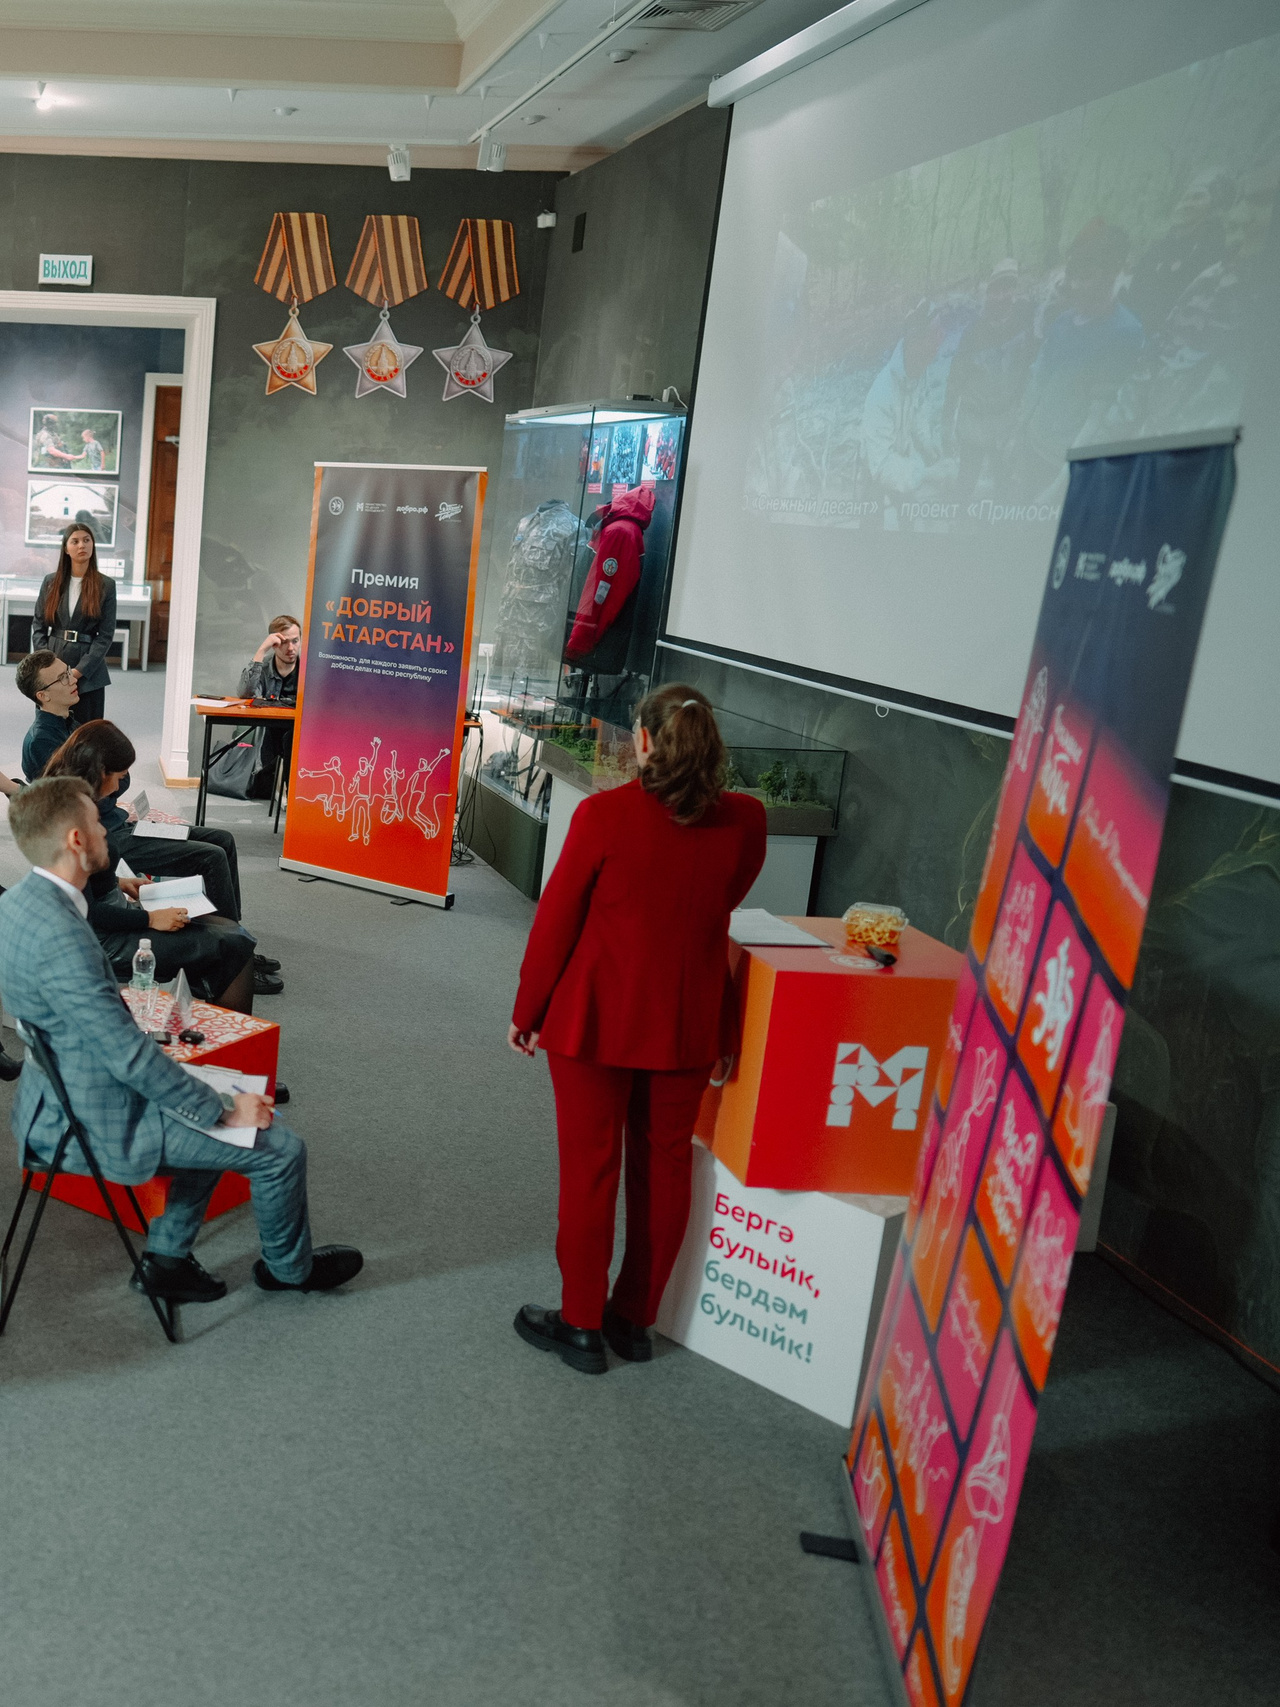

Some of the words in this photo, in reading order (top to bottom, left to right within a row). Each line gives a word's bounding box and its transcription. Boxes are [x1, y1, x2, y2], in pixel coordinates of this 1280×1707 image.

[43, 259, 87, 279] ВЫХОД
[820, 499, 879, 516] десант»
[901, 502, 959, 521] проект
[351, 568, 419, 590] Премия
[322, 621, 455, 654] ТАТАРСТАН»
[318, 651, 357, 663] Возможность
[358, 657, 371, 665] для
[371, 659, 398, 669] каждого
[397, 662, 423, 672] заявить
[427, 667, 448, 676] своих
[330, 661, 355, 671] добрых
[354, 665, 373, 674] делах
[395, 671, 432, 683] республику
[714, 1193, 795, 1243] Бергә
[709, 1227, 820, 1299] булыйк,
[705, 1260, 808, 1324] бердәм
[700, 1293, 813, 1364] булыйк!
